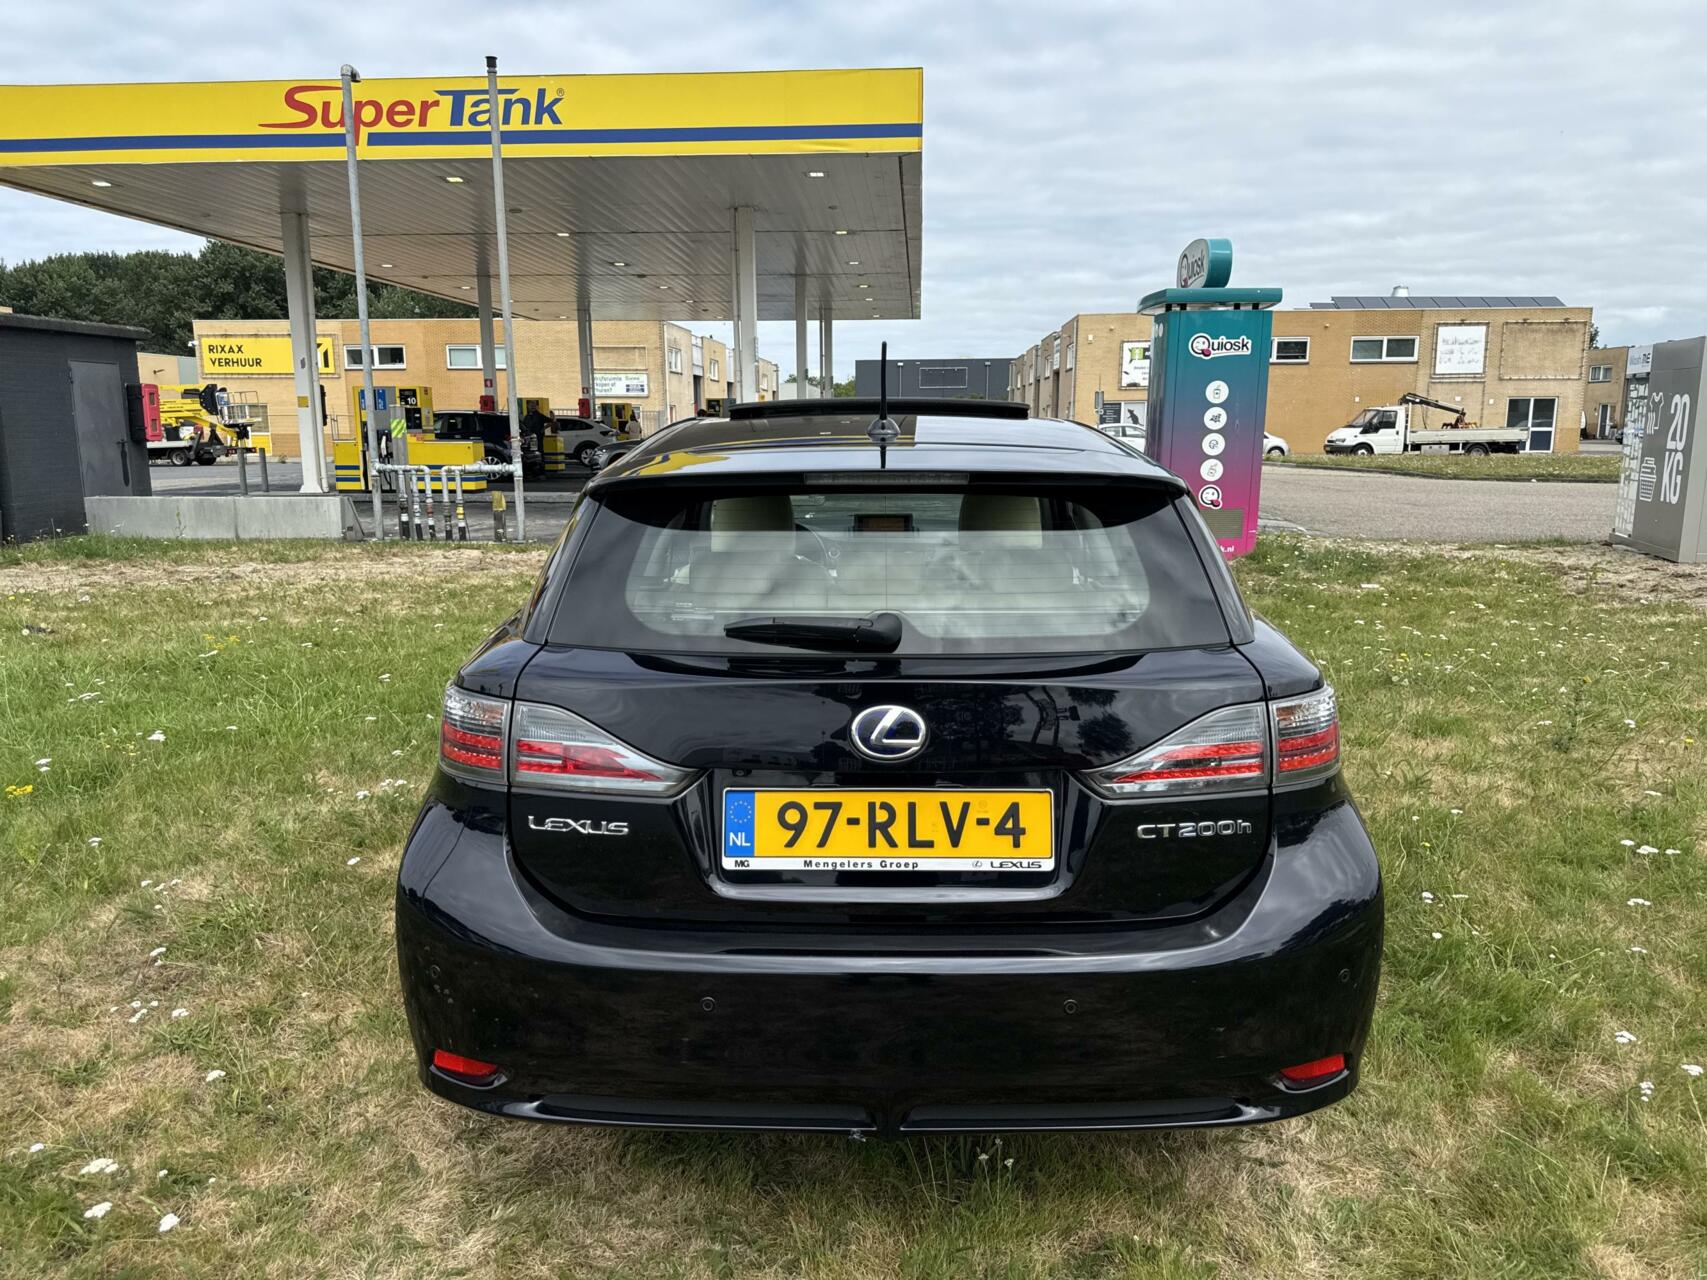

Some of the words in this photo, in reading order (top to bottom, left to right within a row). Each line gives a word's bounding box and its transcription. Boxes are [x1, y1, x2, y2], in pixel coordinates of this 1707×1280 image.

[1180, 249, 1205, 288] Quiosk
[208, 344, 244, 354] RIXAX
[1190, 335, 1250, 357] Quiosk
[210, 358, 262, 368] VERHUUR
[407, 397, 417, 405] 10
[1666, 393, 1690, 451] 20
[1660, 451, 1683, 505] KG
[528, 815, 629, 835] LEXUS
[777, 801, 1027, 849] 97-RLV-4
[729, 832, 751, 847] NL
[734, 859, 750, 868] MG
[803, 859, 873, 870] Mengelers
[880, 859, 919, 870] Groep
[990, 861, 1042, 869] LEXUS
